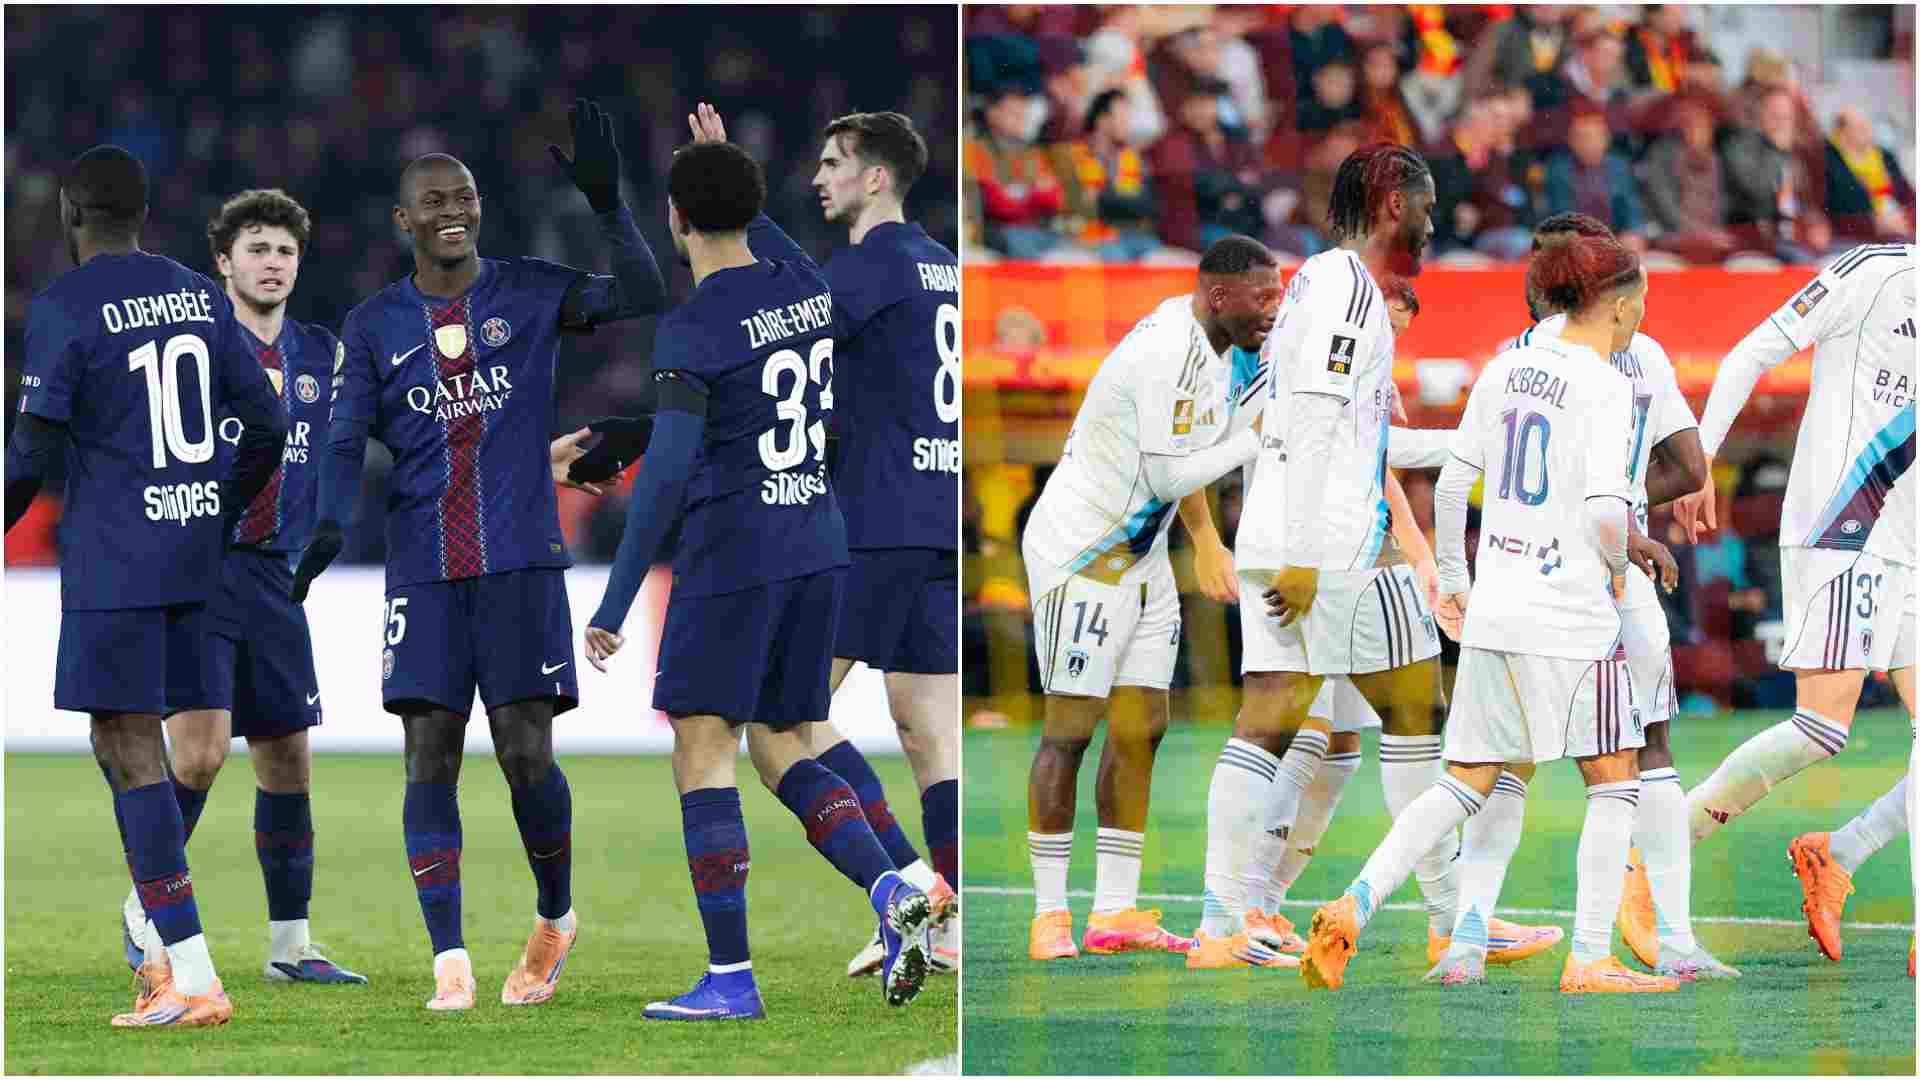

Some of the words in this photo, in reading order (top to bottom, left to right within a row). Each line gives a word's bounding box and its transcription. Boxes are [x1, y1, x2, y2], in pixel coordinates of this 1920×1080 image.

[407, 365, 512, 415] QATAR
[934, 303, 959, 423] 8
[1503, 365, 1569, 410] KBBAL
[1875, 368, 1917, 396] BA
[128, 334, 215, 469] 10
[1625, 383, 1654, 485] 7
[1498, 408, 1551, 506] 10
[1073, 601, 1109, 648] 14
